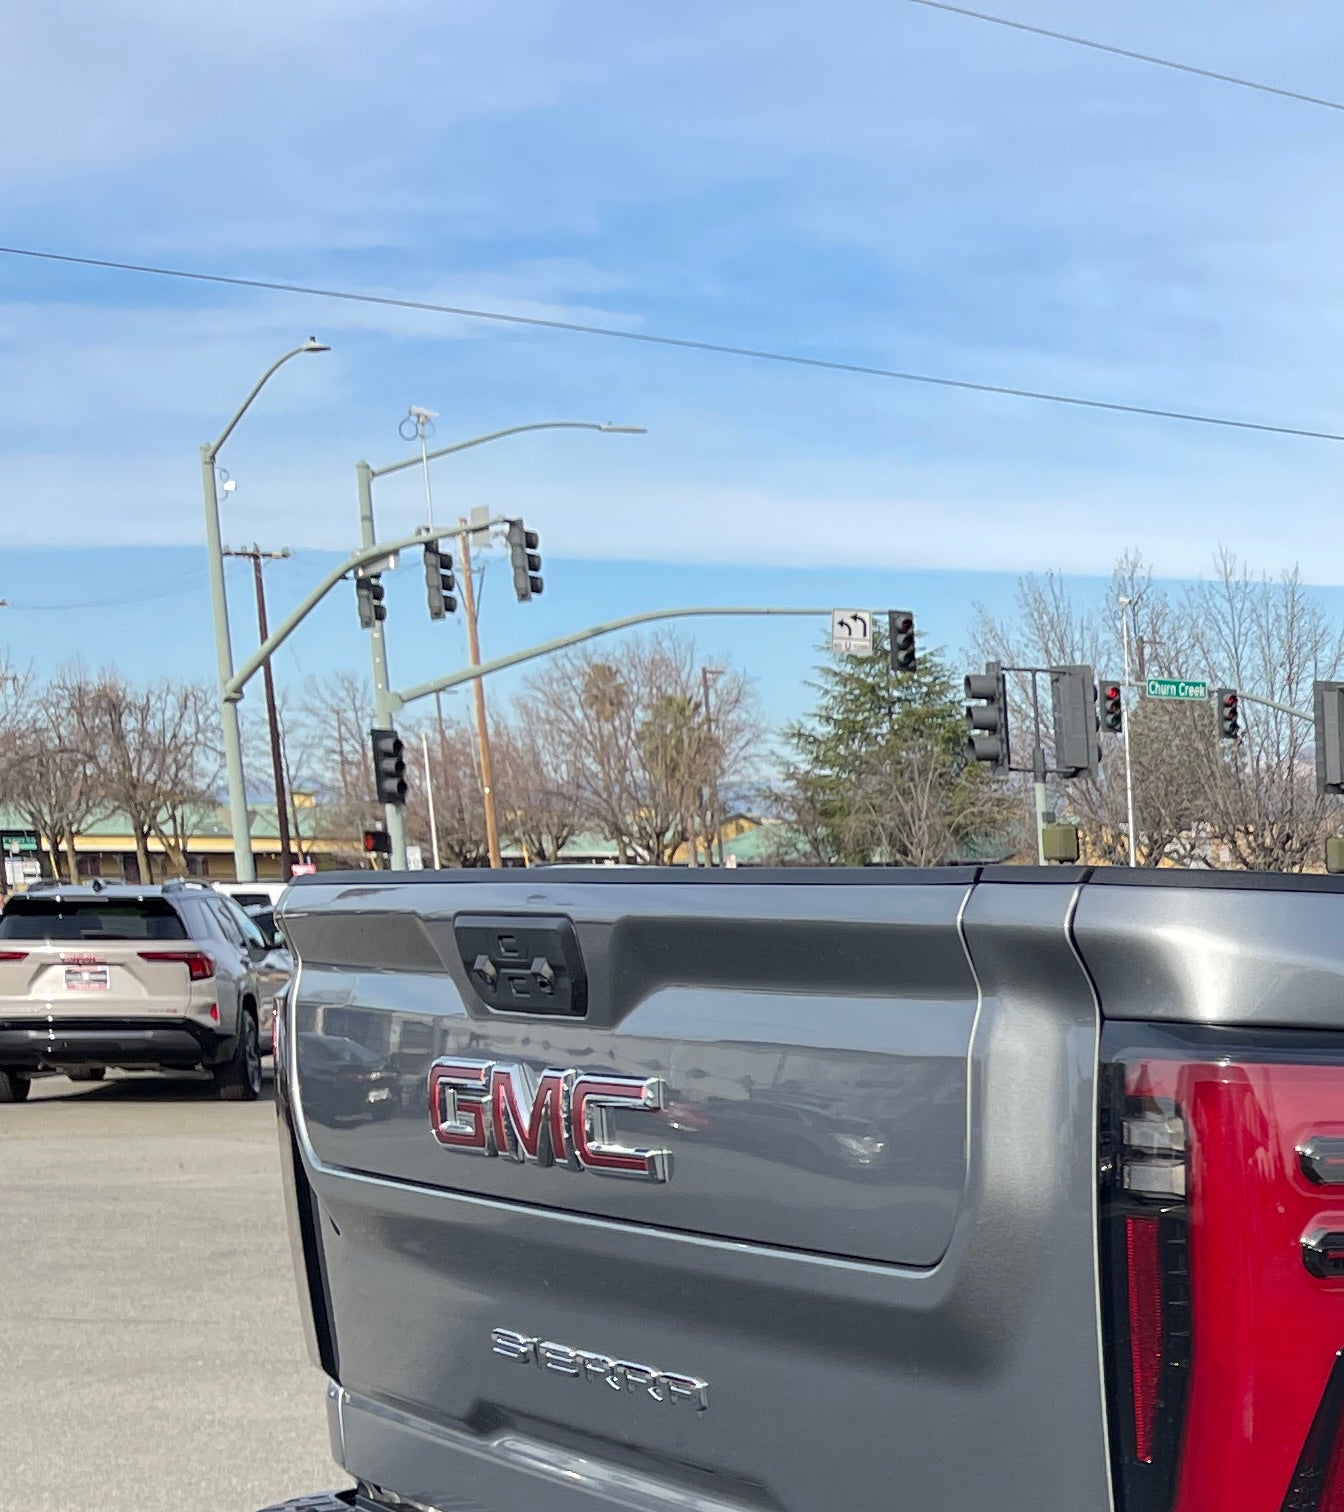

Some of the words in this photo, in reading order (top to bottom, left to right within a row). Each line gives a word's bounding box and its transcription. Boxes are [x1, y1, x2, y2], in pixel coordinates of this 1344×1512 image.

[1149, 681, 1176, 697] Churn
[1178, 682, 1205, 697] Creek
[427, 1055, 673, 1184] GMC
[491, 1327, 709, 1413] SIERRA
